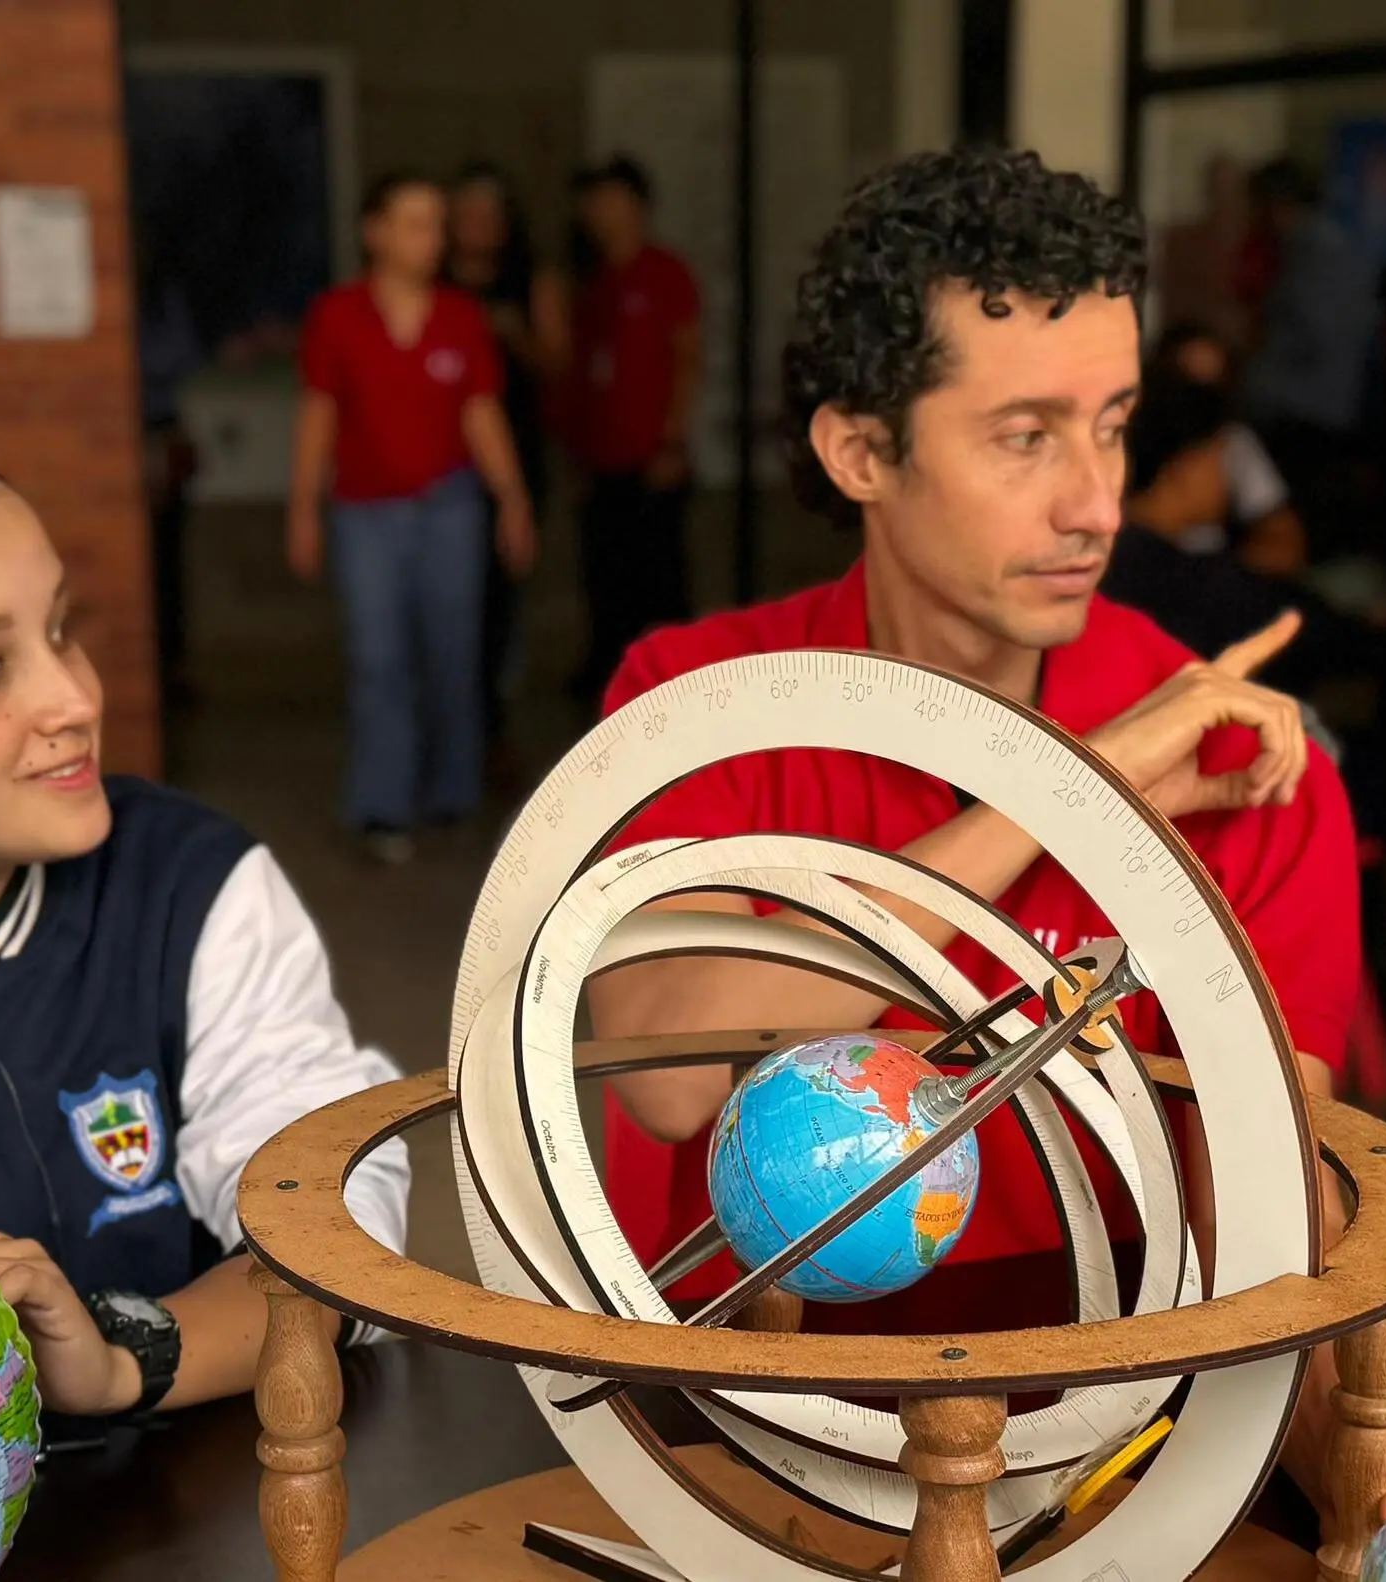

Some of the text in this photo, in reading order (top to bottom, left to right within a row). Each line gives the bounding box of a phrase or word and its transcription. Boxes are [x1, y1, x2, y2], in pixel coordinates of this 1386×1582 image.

[704, 688, 733, 712] 70°
[770, 679, 799, 699] 60°
[841, 681, 873, 702] 50°
[914, 700, 946, 723] 40°
[642, 712, 668, 740] 80°
[985, 732, 1017, 758] 30°
[589, 751, 611, 779] 90°
[1052, 779, 1087, 808] 20°
[508, 854, 529, 887] 70°
[1119, 846, 1149, 874] 10°
[483, 918, 503, 951] 60°
[1205, 963, 1244, 1004] N
[540, 1119, 558, 1164] Octubre
[1005, 1449, 1035, 1463] Mayo
